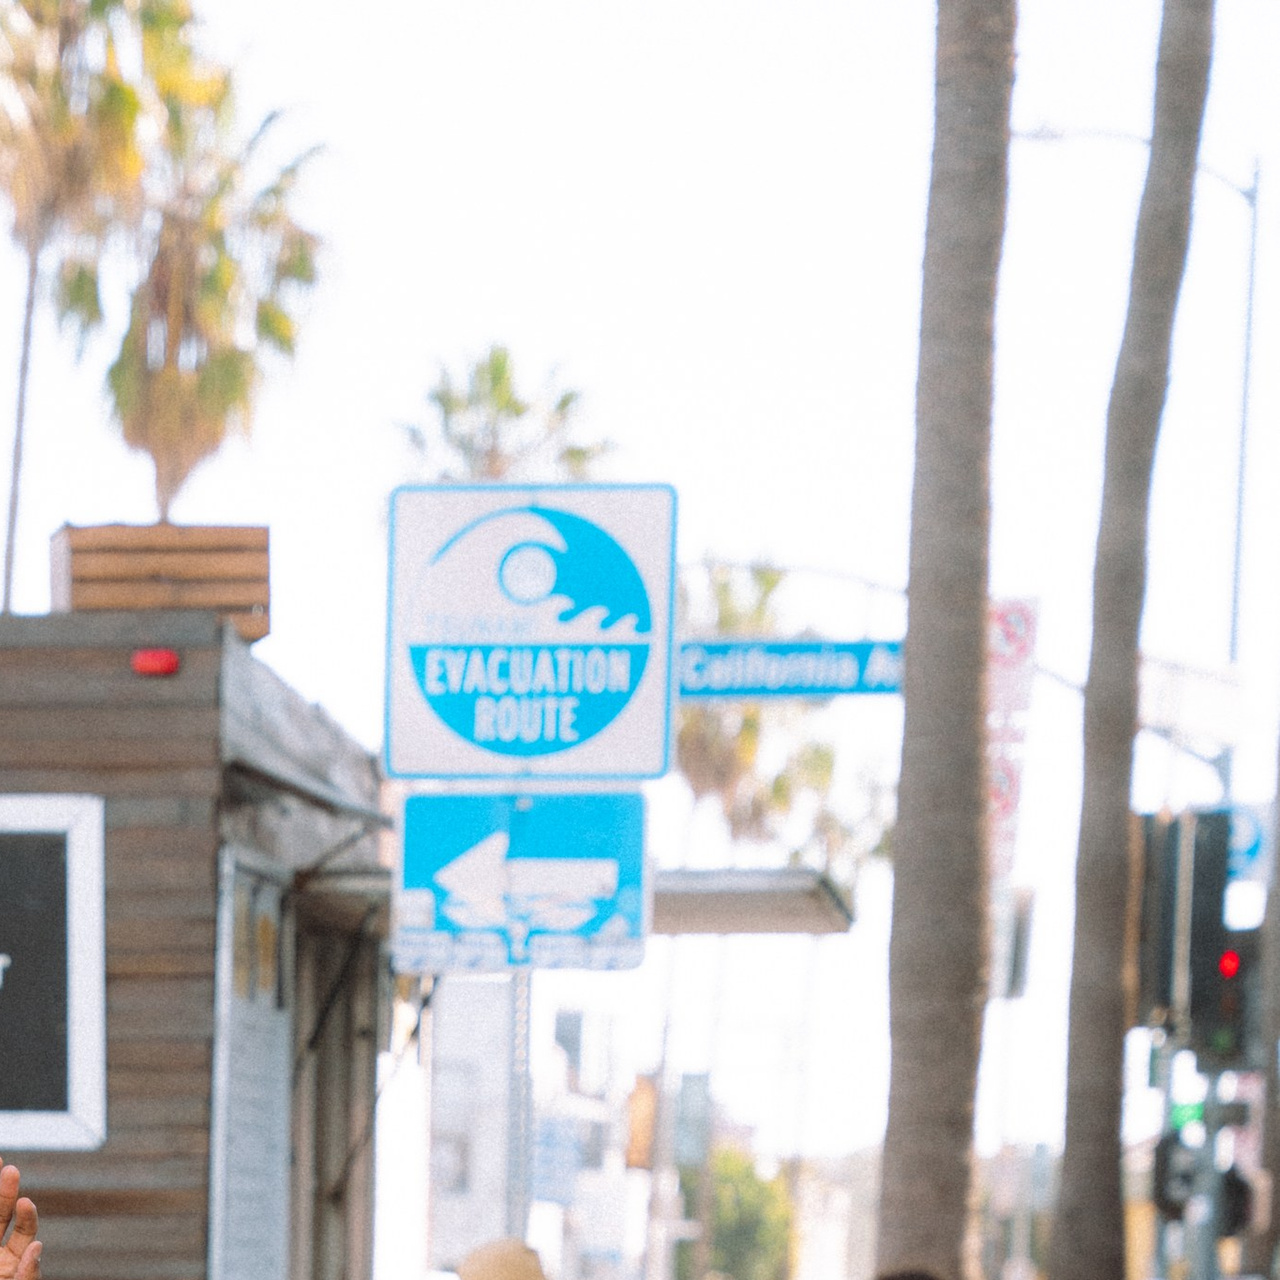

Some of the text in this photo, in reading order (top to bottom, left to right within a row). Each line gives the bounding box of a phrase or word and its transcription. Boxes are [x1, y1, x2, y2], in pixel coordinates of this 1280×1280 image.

[425, 648, 634, 695] EVACUATION
[680, 645, 858, 690] California
[473, 696, 581, 743] ROUTE
